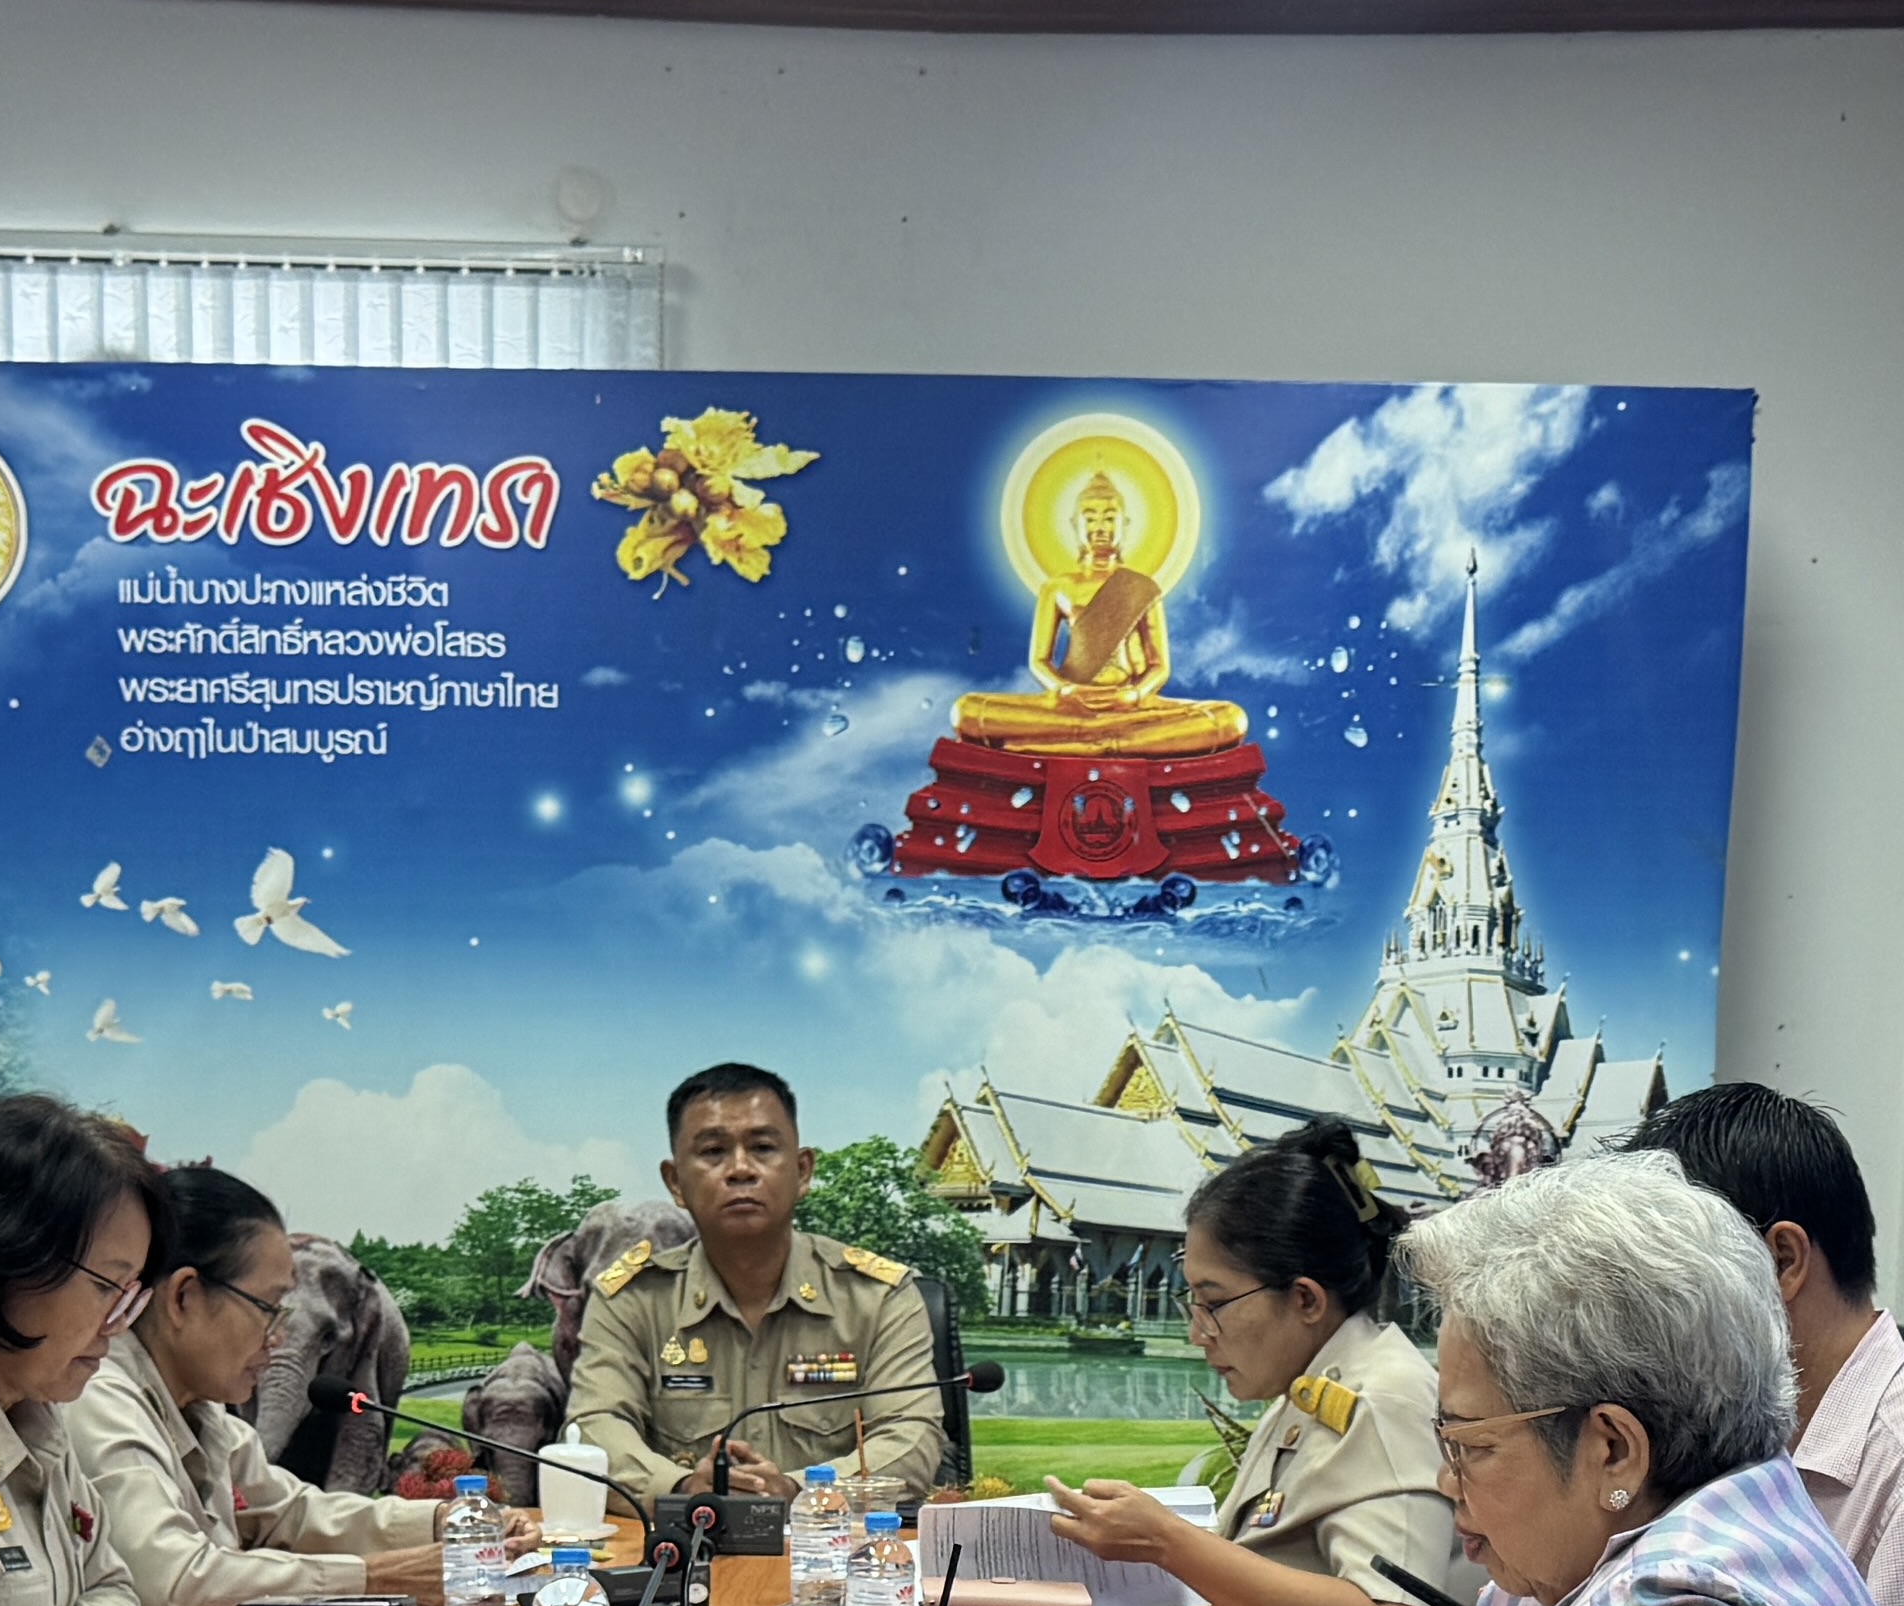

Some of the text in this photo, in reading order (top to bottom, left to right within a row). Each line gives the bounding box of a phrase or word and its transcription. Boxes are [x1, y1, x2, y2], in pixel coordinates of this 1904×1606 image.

[93, 418, 560, 549] ฉะเชิงเทรา
[117, 565, 449, 608] แม่น้ำบางปะกงแหล่งชีวิต
[117, 617, 507, 659] พระศักดิ์สิทธิ์หลวงพ่อโสธร
[118, 671, 560, 712] พระยาศรีสุนทรปราชญ์ภาษาไทย
